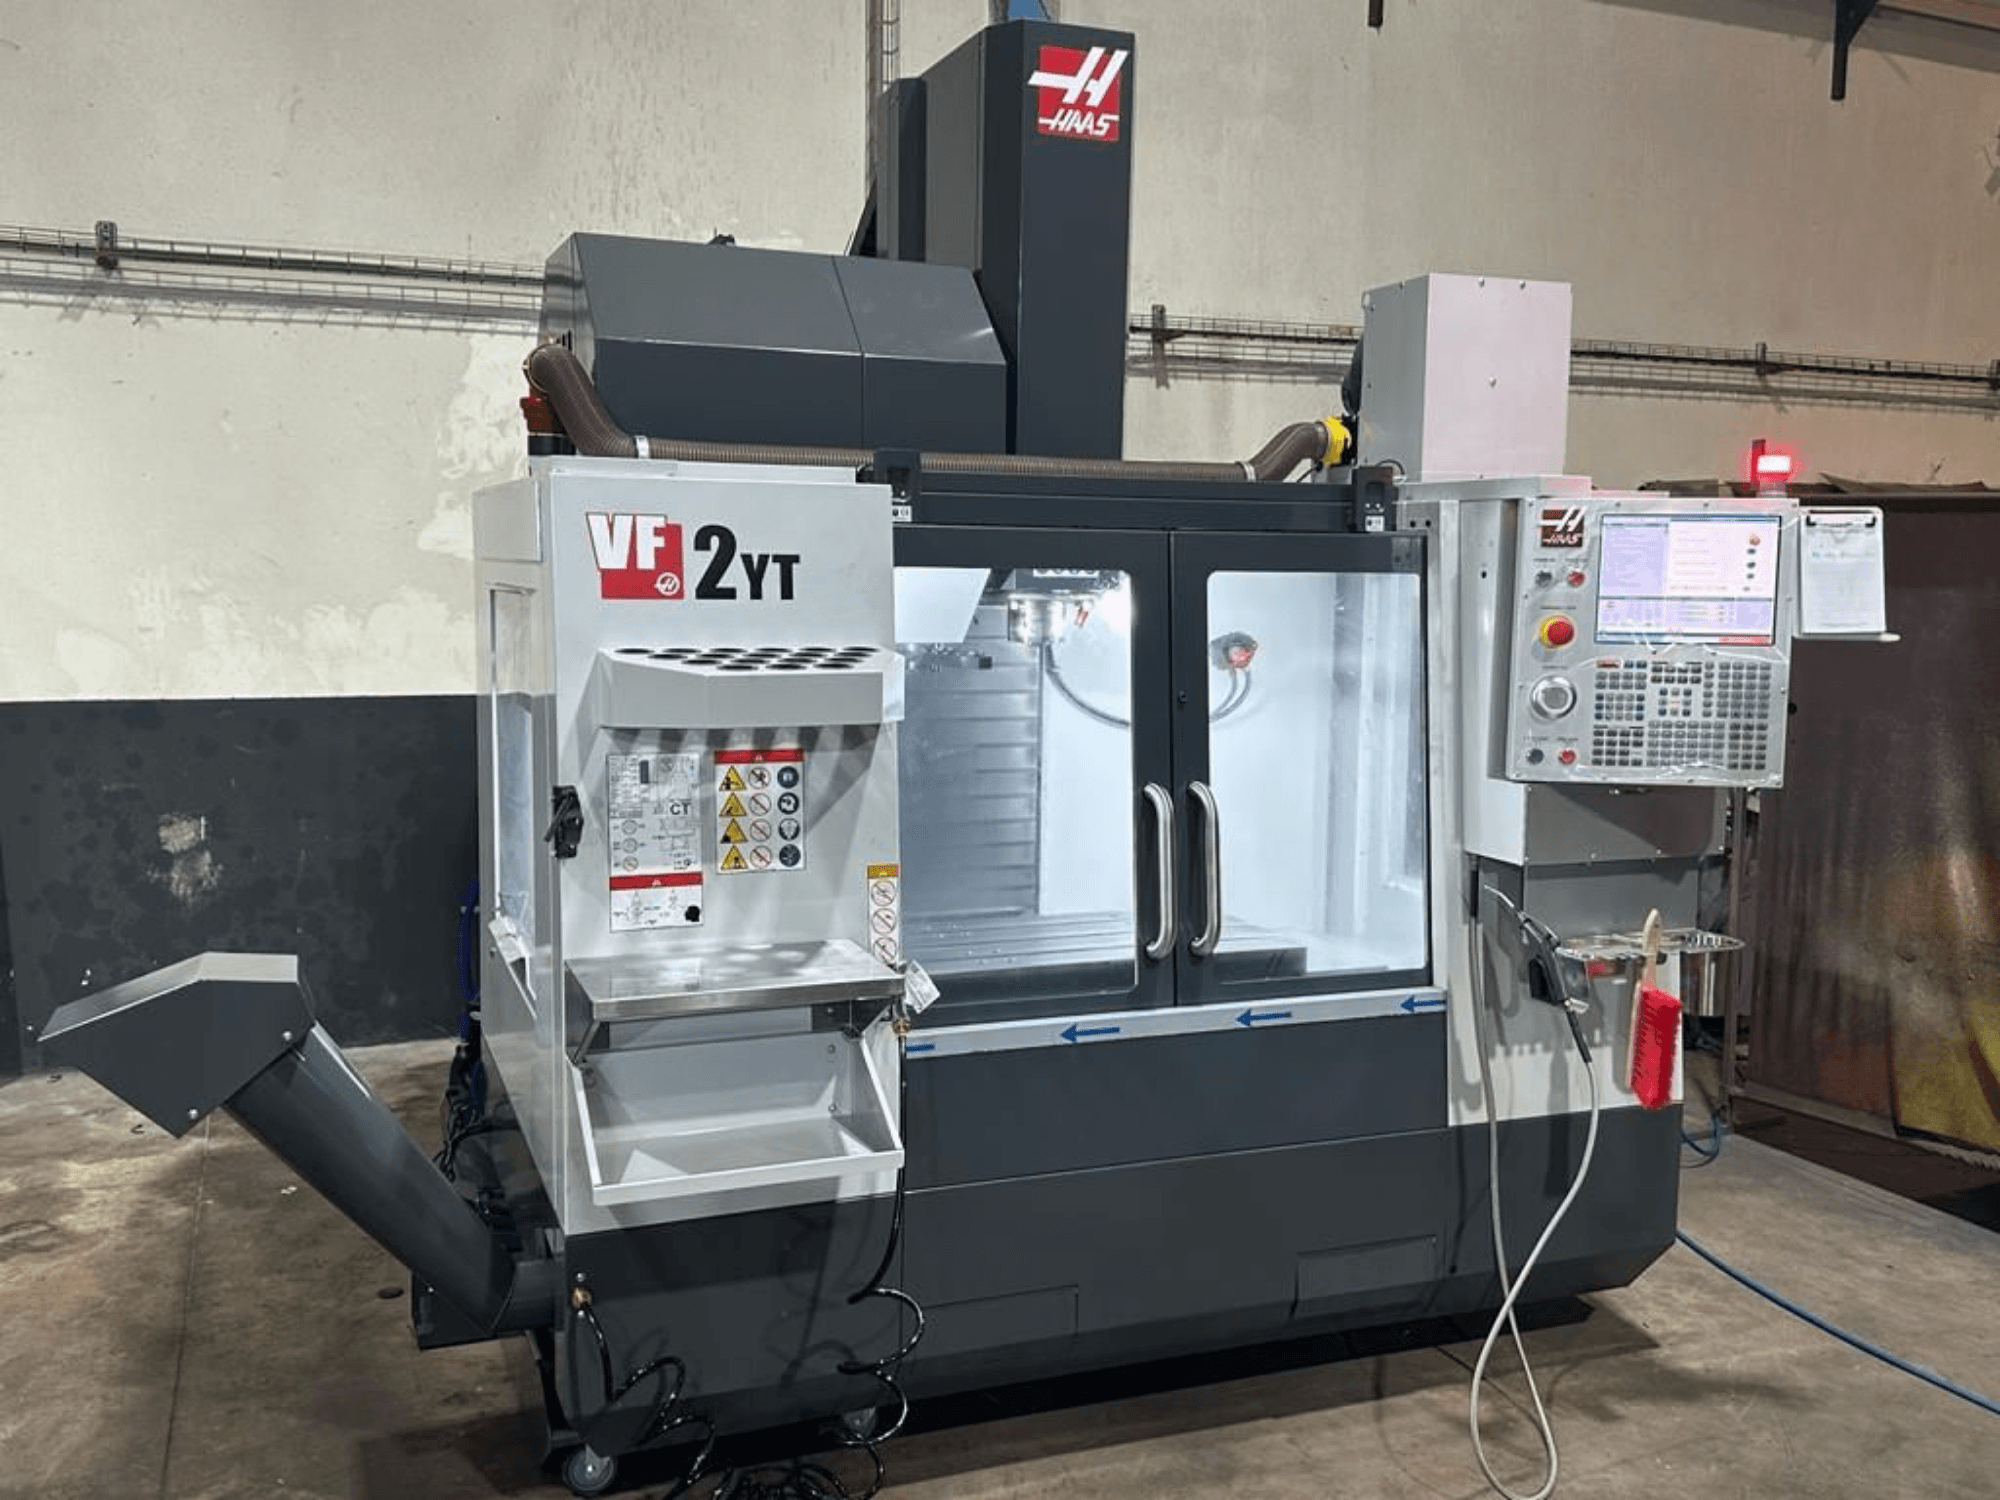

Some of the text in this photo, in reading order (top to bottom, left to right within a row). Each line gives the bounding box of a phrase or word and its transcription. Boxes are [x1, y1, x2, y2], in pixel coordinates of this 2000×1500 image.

[1038, 107, 1120, 136] HAAS
[586, 512, 667, 570] VF
[669, 801, 693, 816] CT
